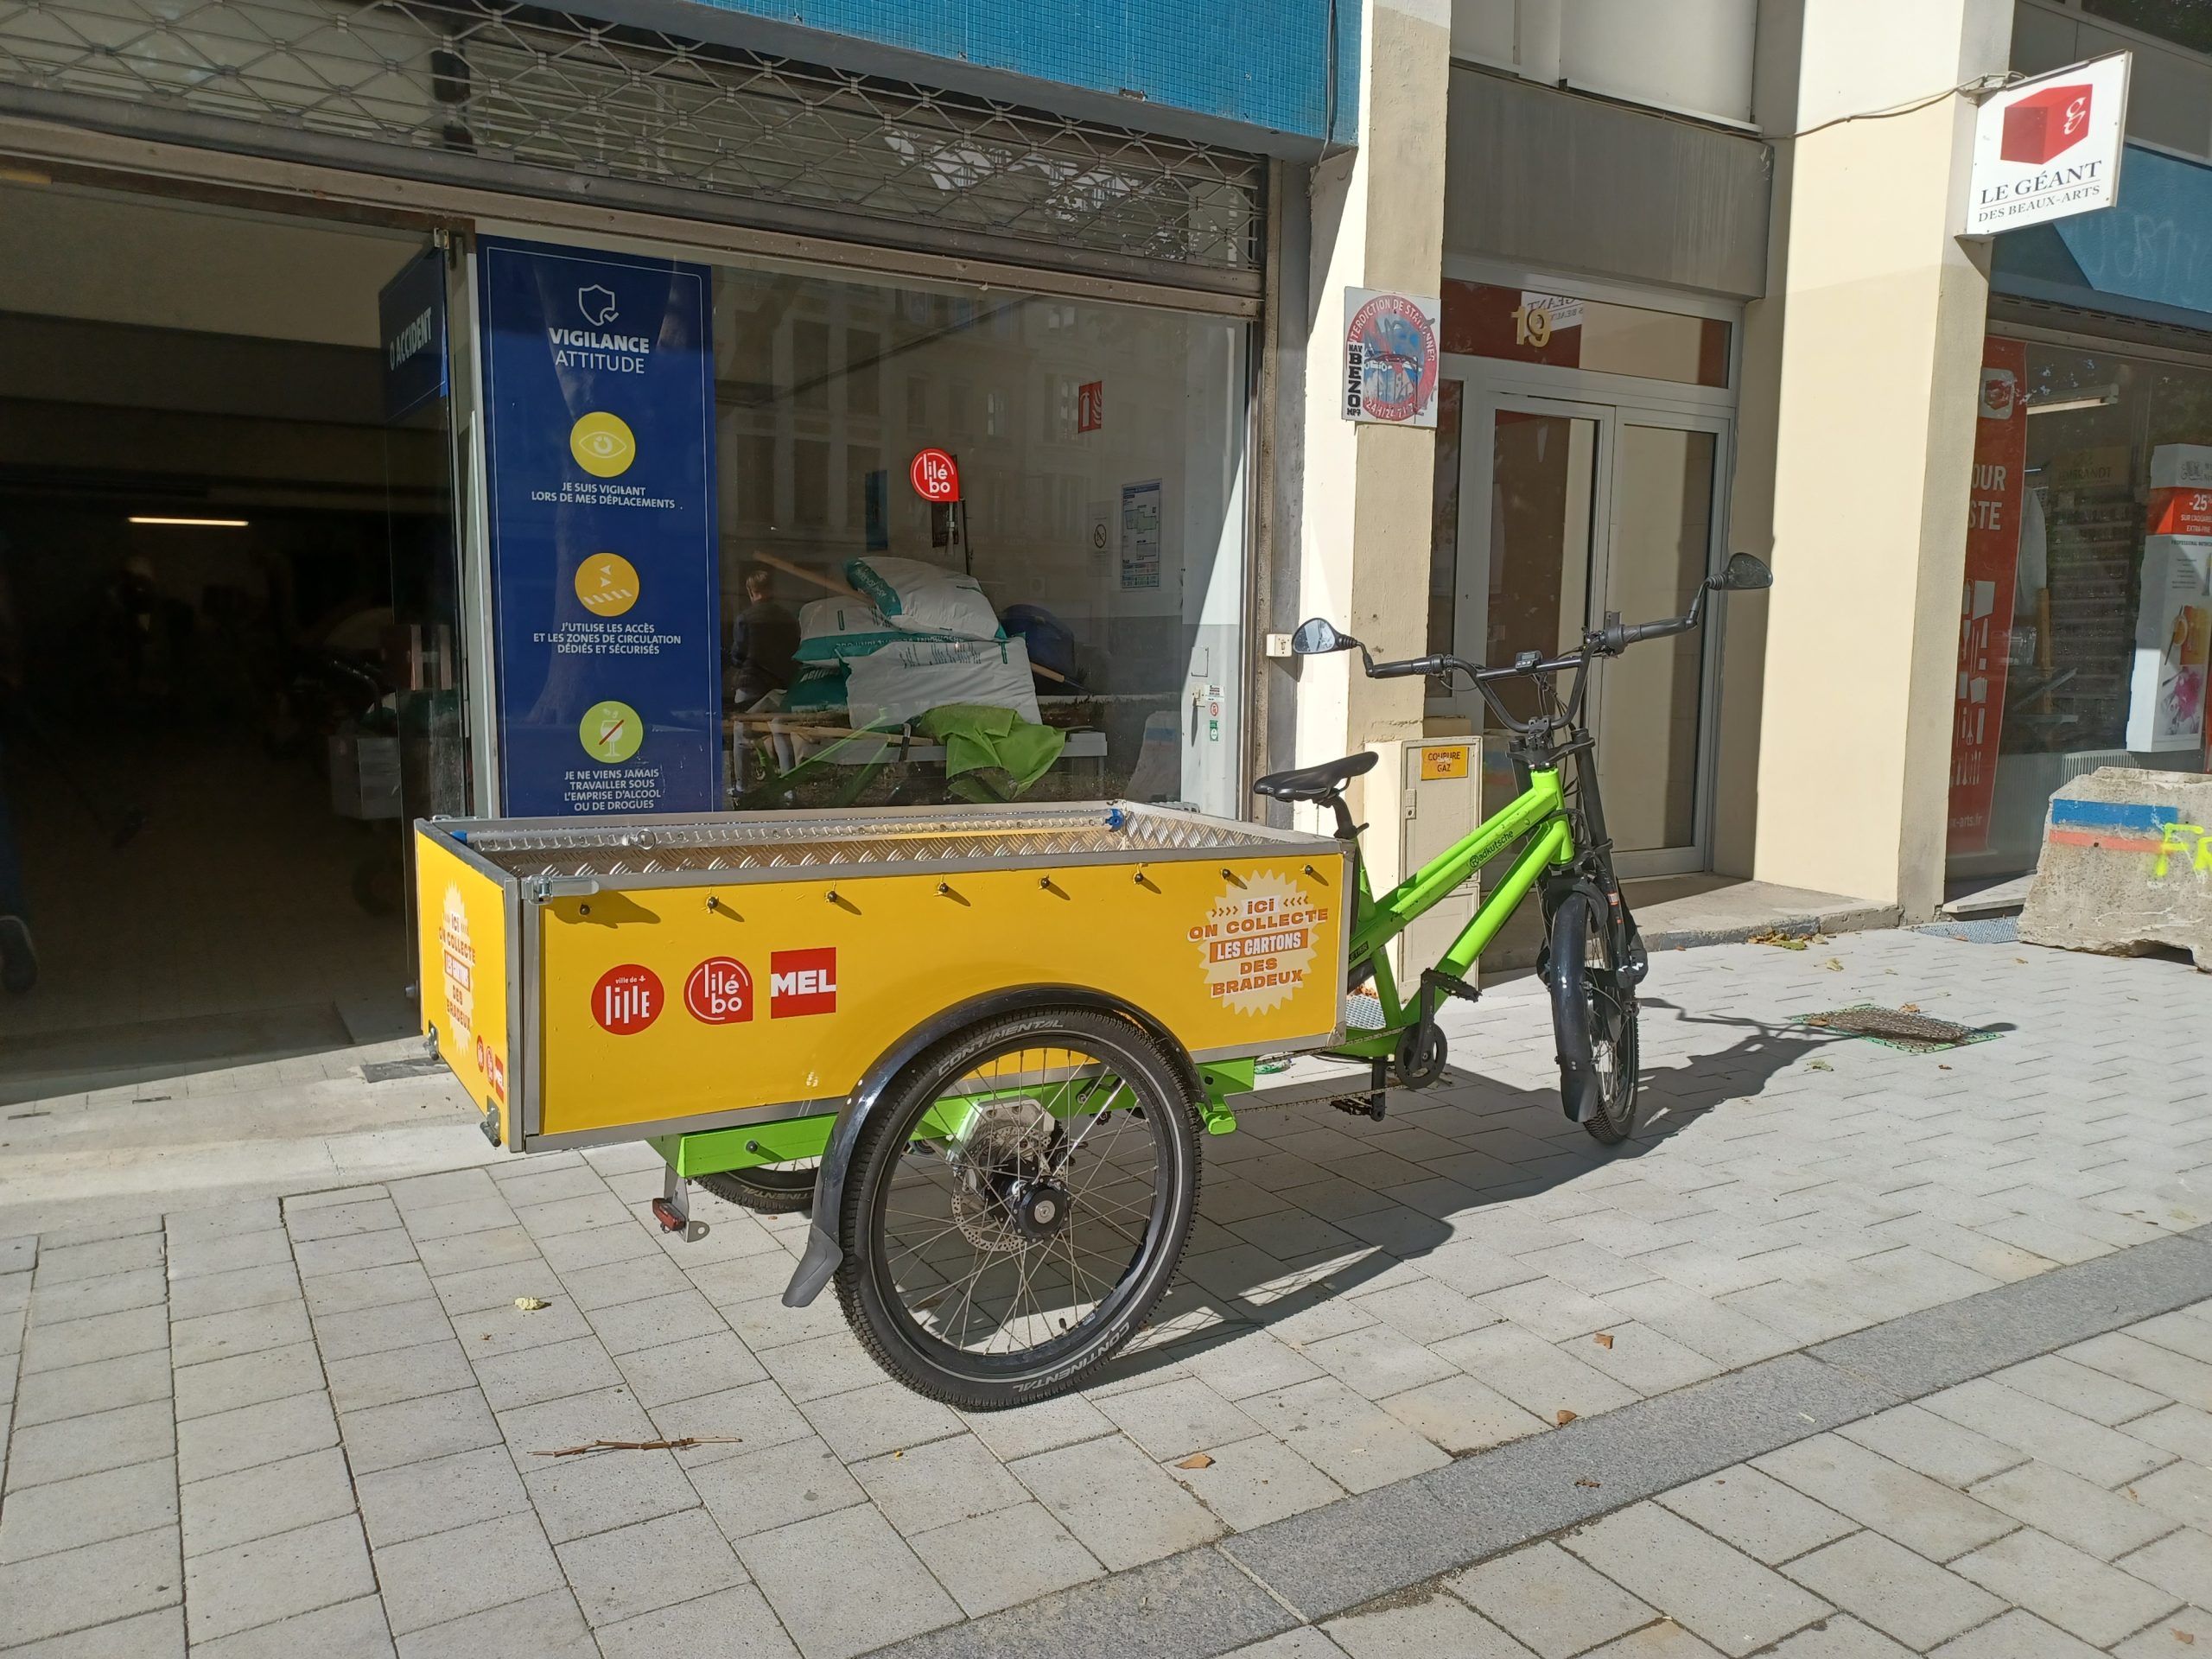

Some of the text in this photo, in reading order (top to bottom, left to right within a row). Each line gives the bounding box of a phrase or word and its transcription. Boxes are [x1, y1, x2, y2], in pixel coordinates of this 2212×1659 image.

[1980, 160, 2102, 206] LE GÉANT
[1978, 185, 2101, 222] DES BEAUX-ARTS
[1510, 305, 1552, 347] 19
[396, 306, 432, 367] ACCIDENT
[549, 327, 650, 354] VIGILANCE
[555, 349, 645, 374] ATTITUDE
[562, 482, 646, 496] JE SUIS VIGILANT
[929, 476, 950, 493] bo
[531, 491, 676, 509] LORS DE MES DÉPLACEMENTS
[607, 623, 623, 632] LES
[625, 622, 655, 633] ACCÈS
[533, 632, 682, 645] ET LES ZONES DE CIRCULATION
[557, 642, 660, 654] DÉDIÉS ET SÉCURISÉS
[1427, 751, 1461, 761] COUPURE
[564, 768, 659, 780] JE NE VIENS JAMAIS
[1437, 764, 1451, 772] GAZ
[569, 779, 655, 791] TRAVAILLER SOUS
[574, 800, 654, 811] OU DE DROGUES
[1189, 908, 1328, 939] ON COLLECTE
[1217, 931, 1302, 960] LES CARTONS
[1240, 957, 1278, 975] DES
[770, 969, 836, 997] MEL
[1212, 969, 1304, 996] BRADEUX
[711, 994, 742, 1014] bo
[938, 1020, 1064, 1077] CONTINENTAL
[1013, 1322, 1130, 1393] CONTINENTAL
